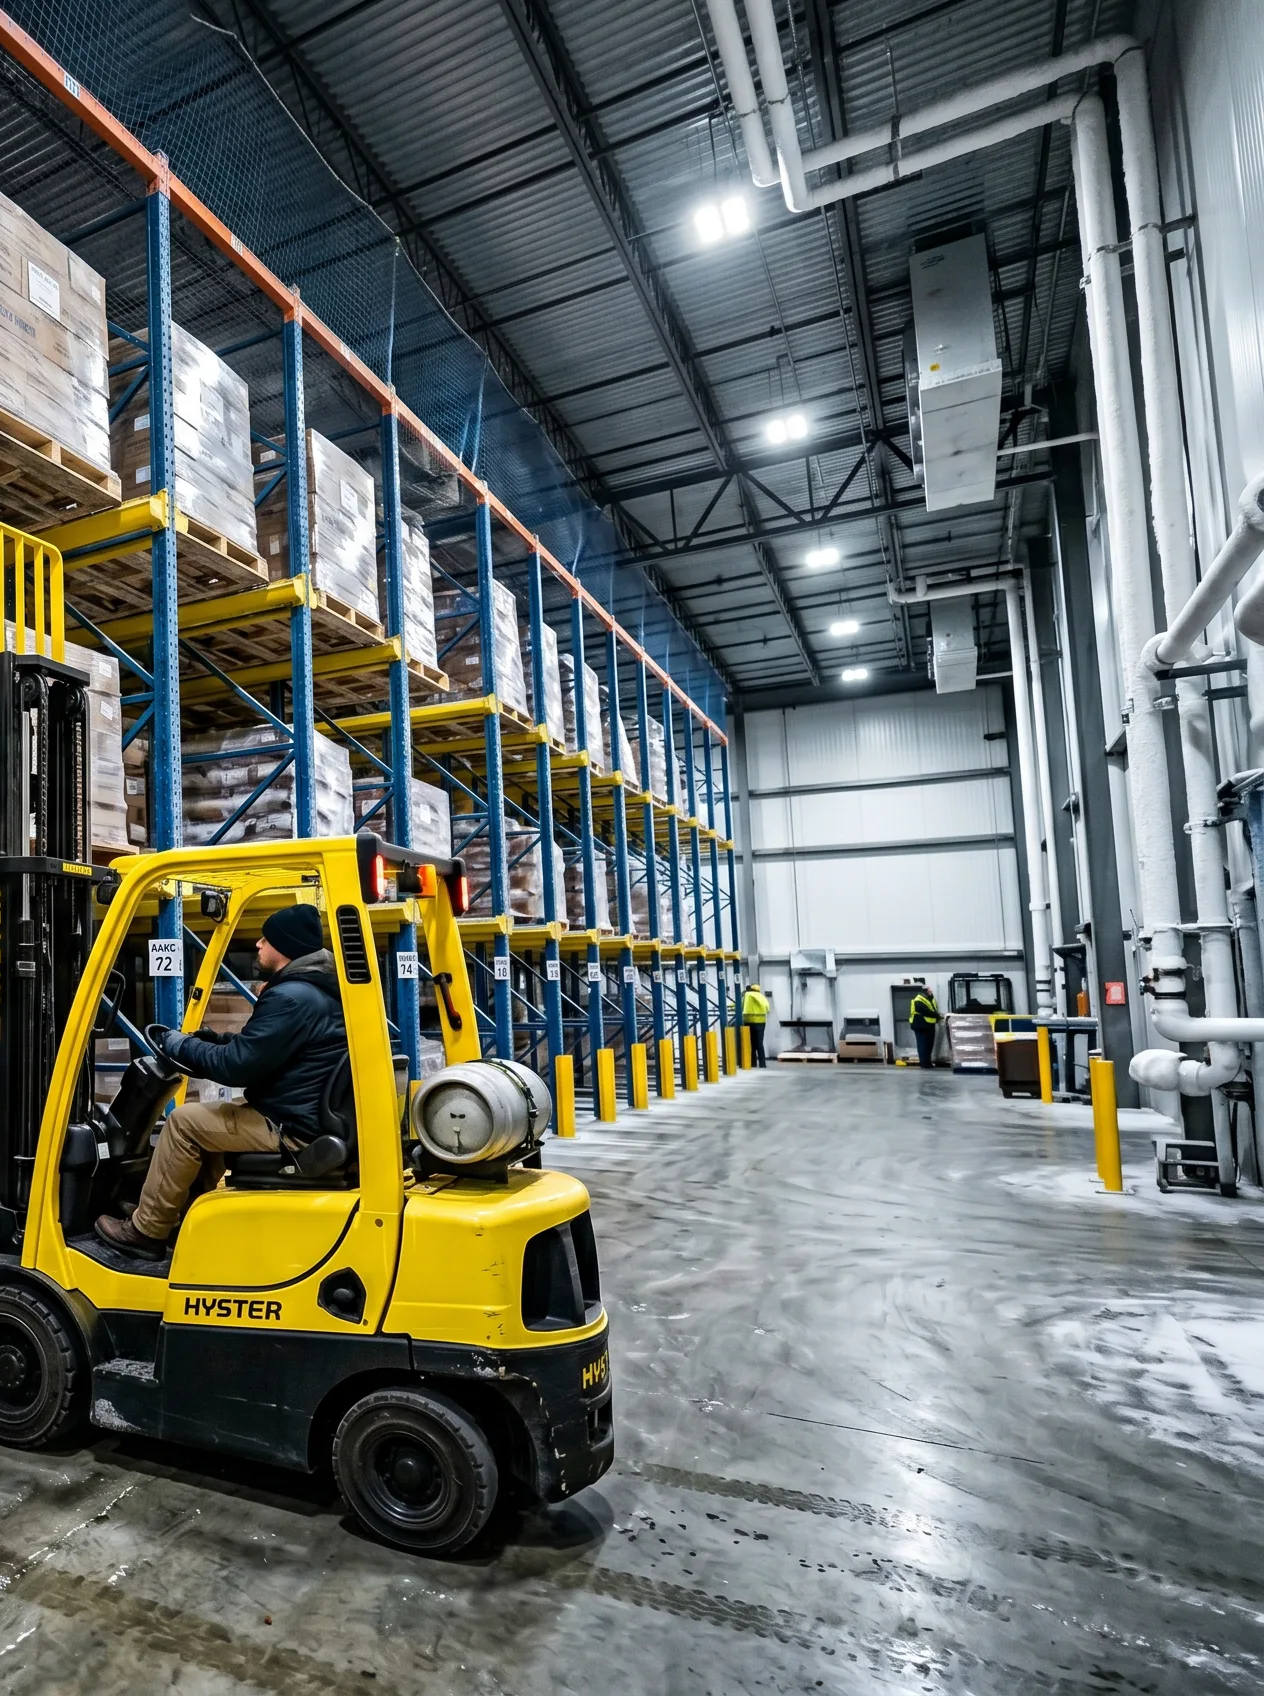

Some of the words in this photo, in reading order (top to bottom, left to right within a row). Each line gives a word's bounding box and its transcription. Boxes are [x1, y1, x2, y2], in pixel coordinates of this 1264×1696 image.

[151, 944, 176, 952] AAKC
[156, 956, 172, 971] 72
[401, 963, 413, 975] 74
[184, 1297, 283, 1321] HYSTER
